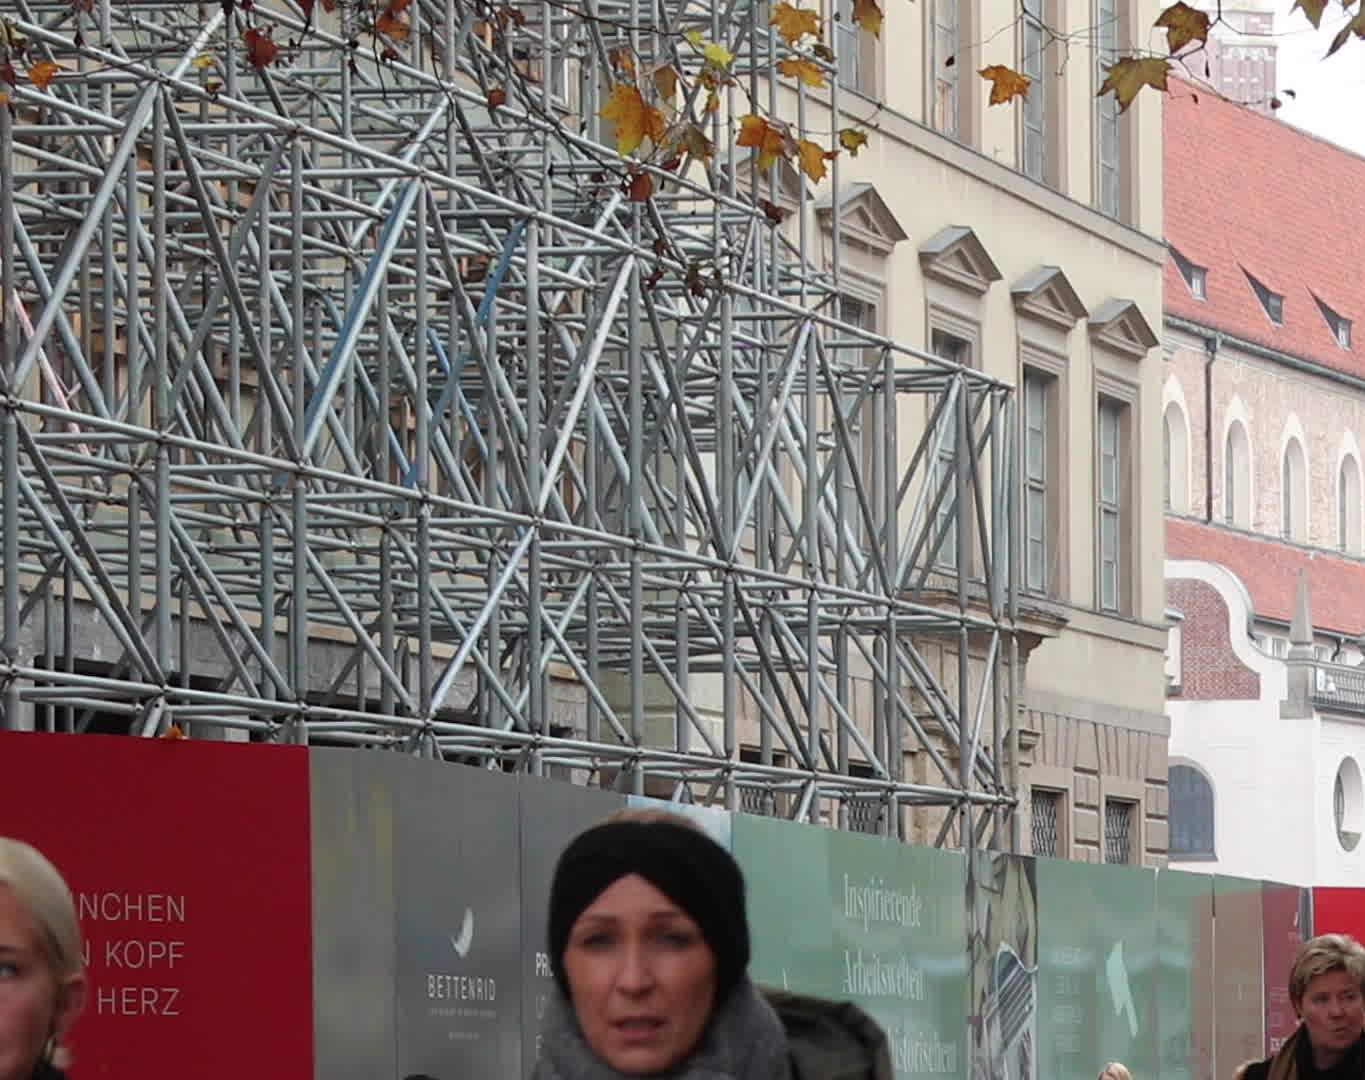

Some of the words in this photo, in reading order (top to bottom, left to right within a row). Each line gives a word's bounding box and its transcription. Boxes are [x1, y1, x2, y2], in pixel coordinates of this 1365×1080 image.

[79, 892, 186, 923] NCHEN
[105, 939, 185, 970] KOPF
[98, 987, 181, 1016] HERZ
[427, 974, 497, 1001] BETTENRID
